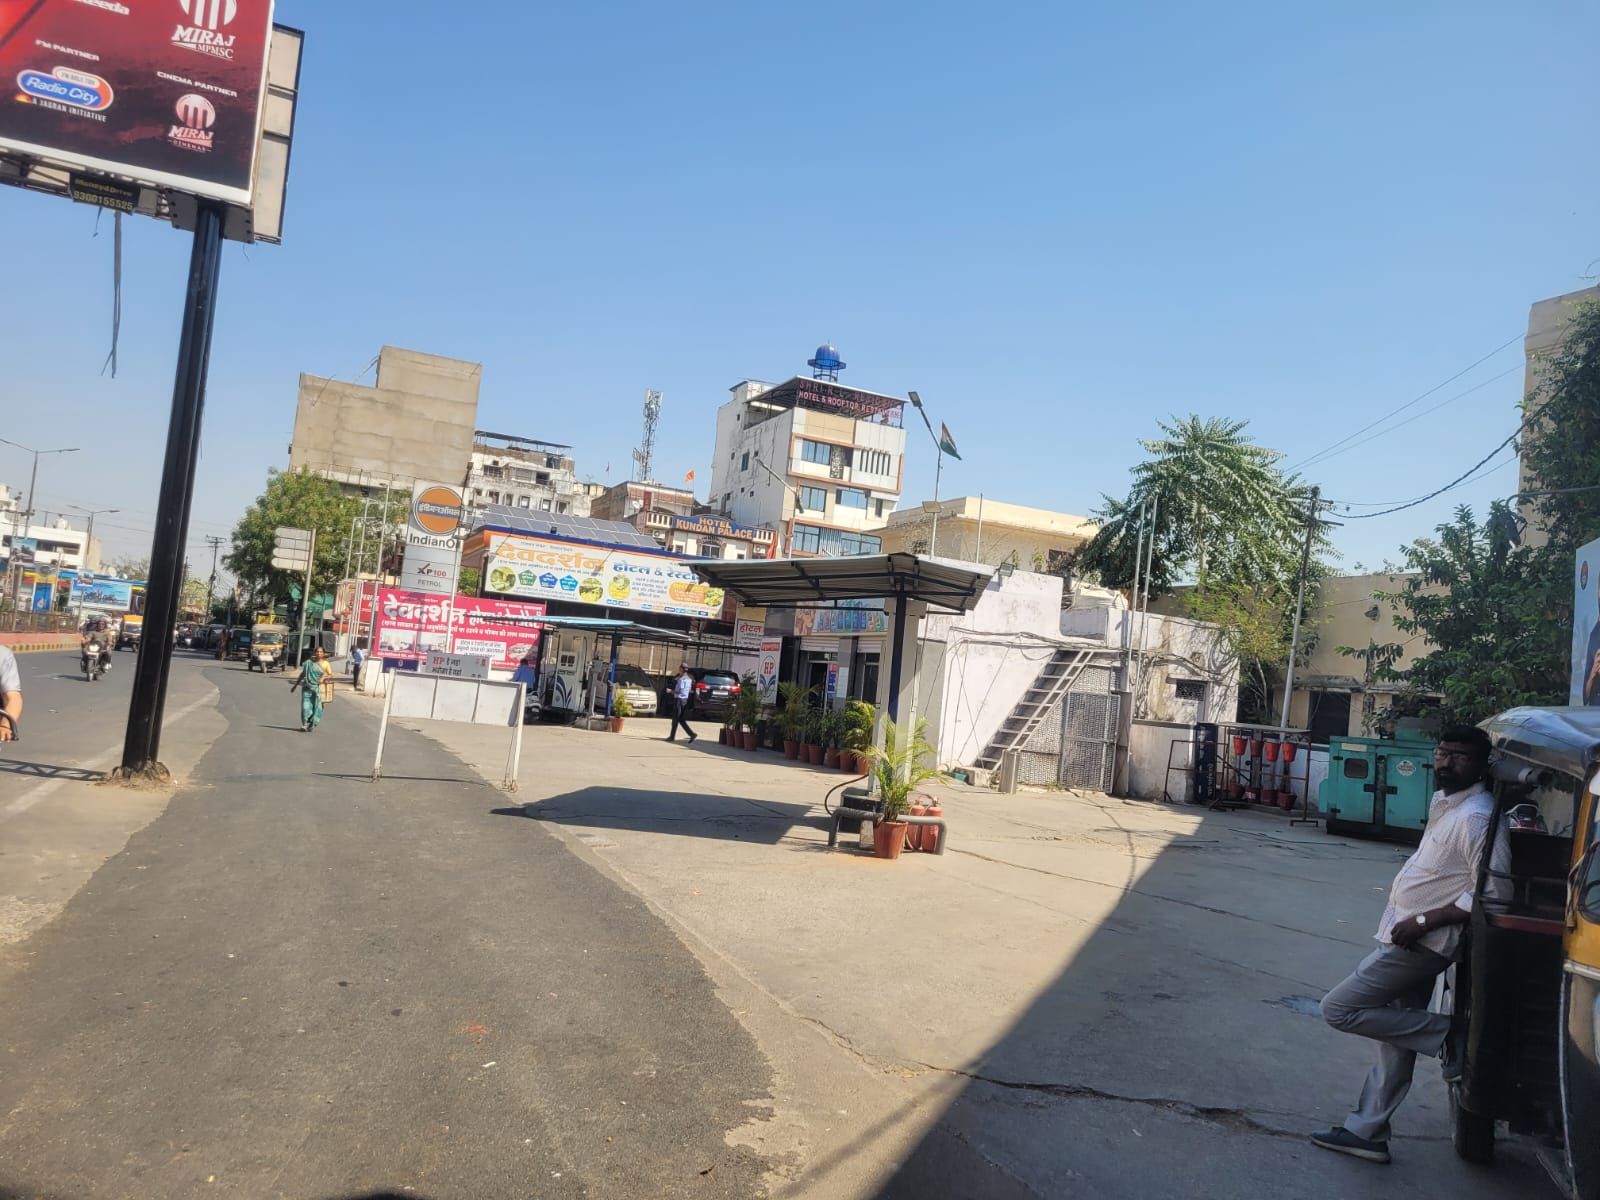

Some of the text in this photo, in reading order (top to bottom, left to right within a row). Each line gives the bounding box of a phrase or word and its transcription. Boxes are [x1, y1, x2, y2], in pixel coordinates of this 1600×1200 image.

[171, 24, 236, 47] MIRAJ
[53, 44, 100, 61] PARTNER
[197, 44, 234, 59] MPMSC
[26, 76, 99, 105] Radio City
[157, 71, 238, 97] CINEMA PARTNER
[39, 99, 68, 113] JAGRAN
[69, 107, 107, 122] INITIATIVE
[168, 125, 214, 140] MIRAJ
[799, 391, 820, 402] HOTEL
[827, 396, 860, 410] ROOFTOP
[676, 519, 753, 539] KUNDAN PALACE
[698, 517, 732, 529] HOTEL
[409, 533, 458, 549] IndianO
[496, 542, 608, 572] देवदर्शन
[613, 559, 650, 575] होटल
[654, 567, 663, 577] &
[417, 578, 441, 588] PETROL
[384, 594, 467, 624] देवदर्शन
[739, 622, 761, 633] होटल
[433, 656, 445, 665] HP
[764, 661, 774, 675] HP
